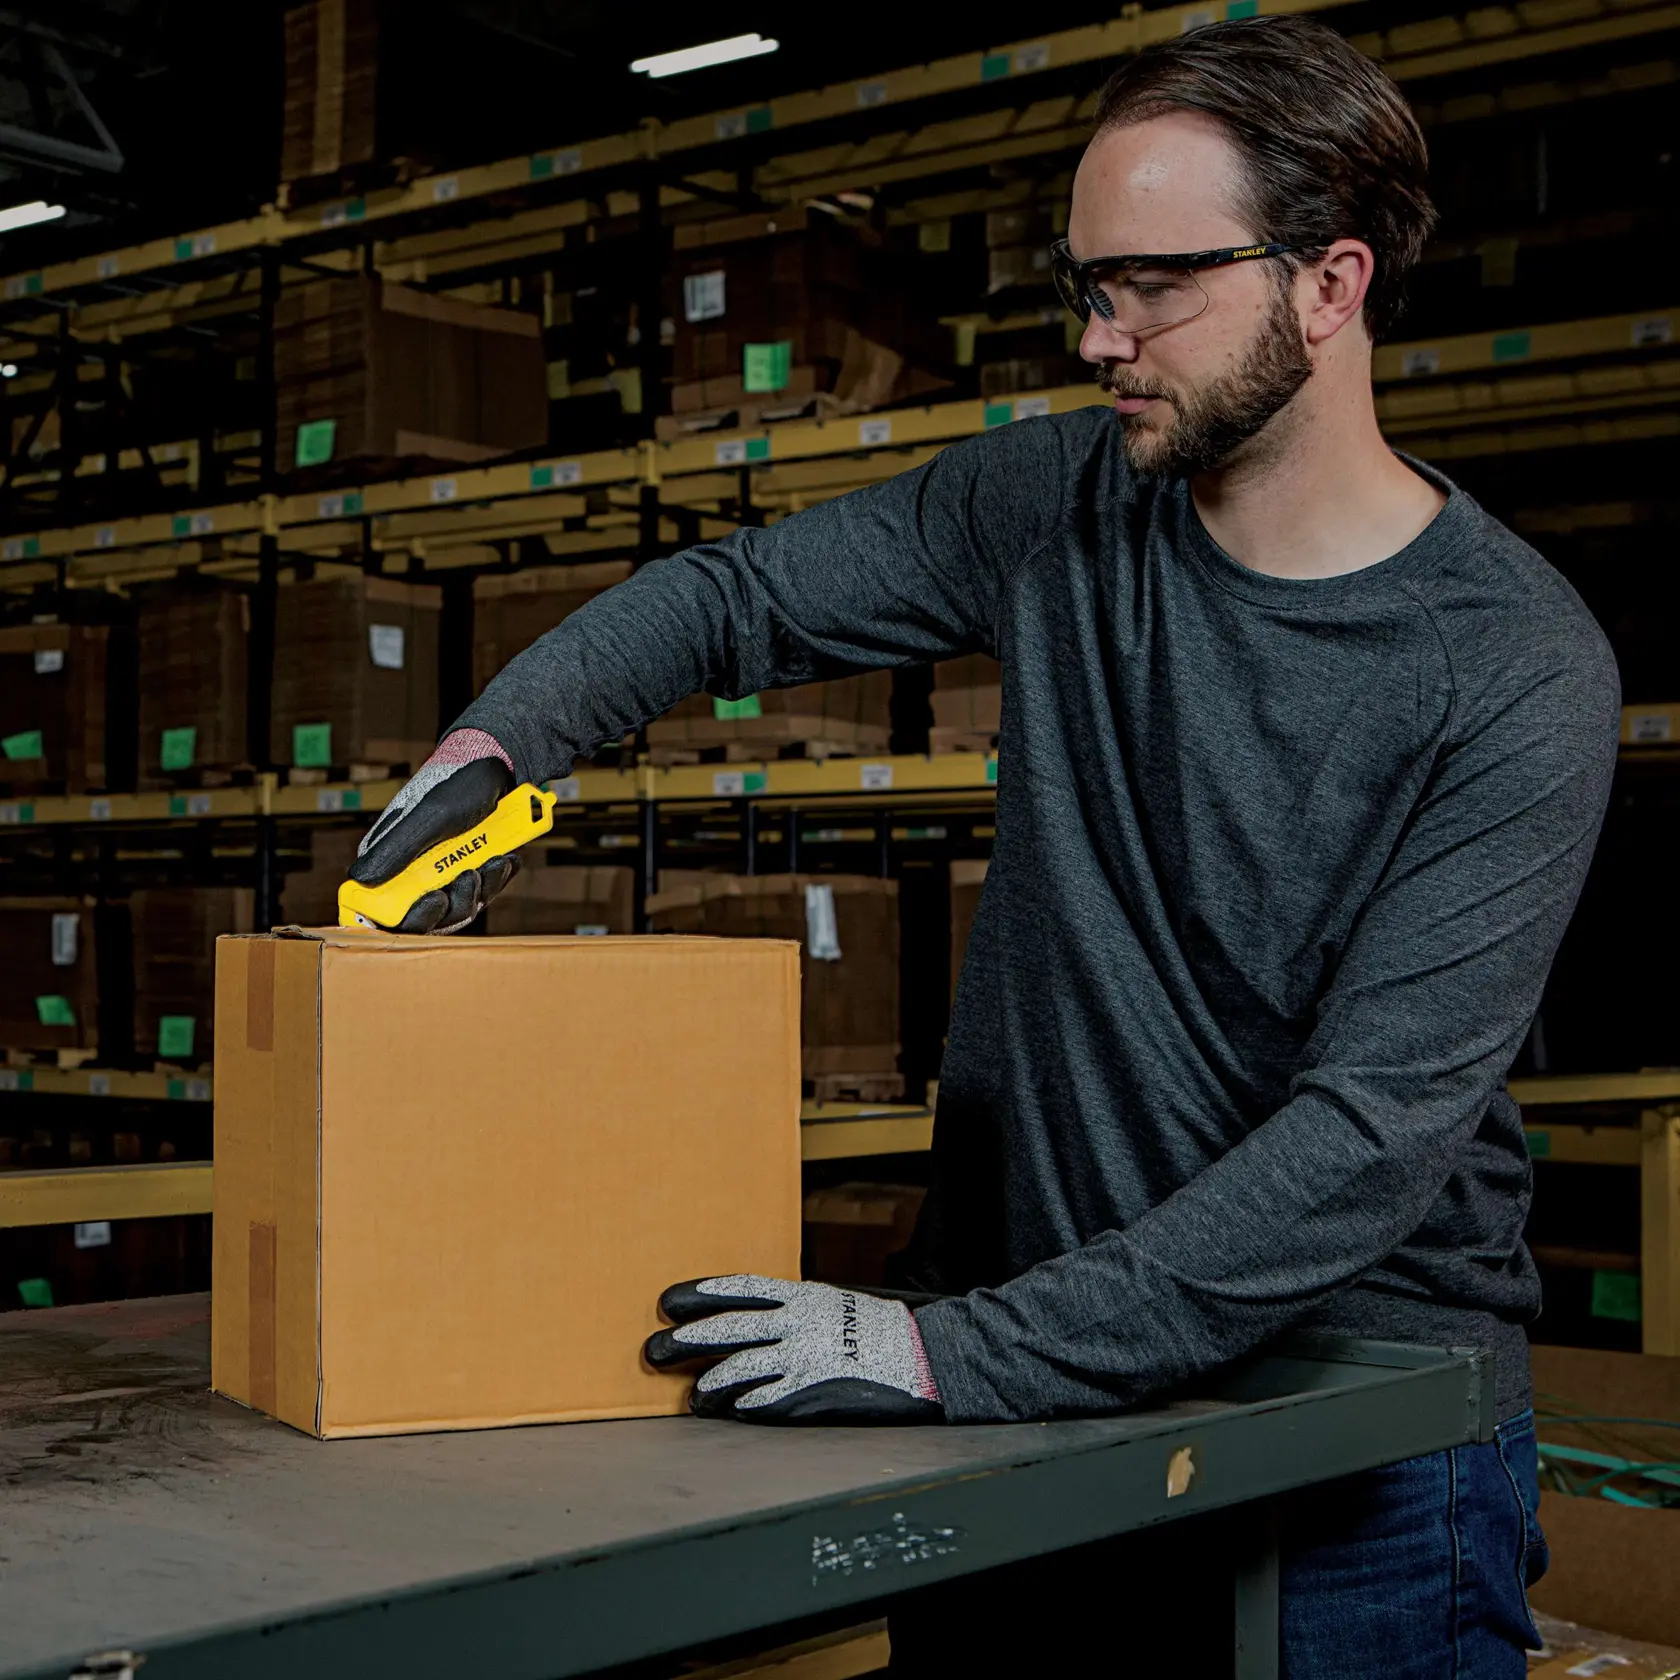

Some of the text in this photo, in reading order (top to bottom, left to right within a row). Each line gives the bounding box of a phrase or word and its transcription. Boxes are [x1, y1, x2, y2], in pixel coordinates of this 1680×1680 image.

[1233, 247, 1266, 258] STANLEY
[433, 833, 488, 873] STANLEY
[841, 1292, 859, 1362] STANLEY
